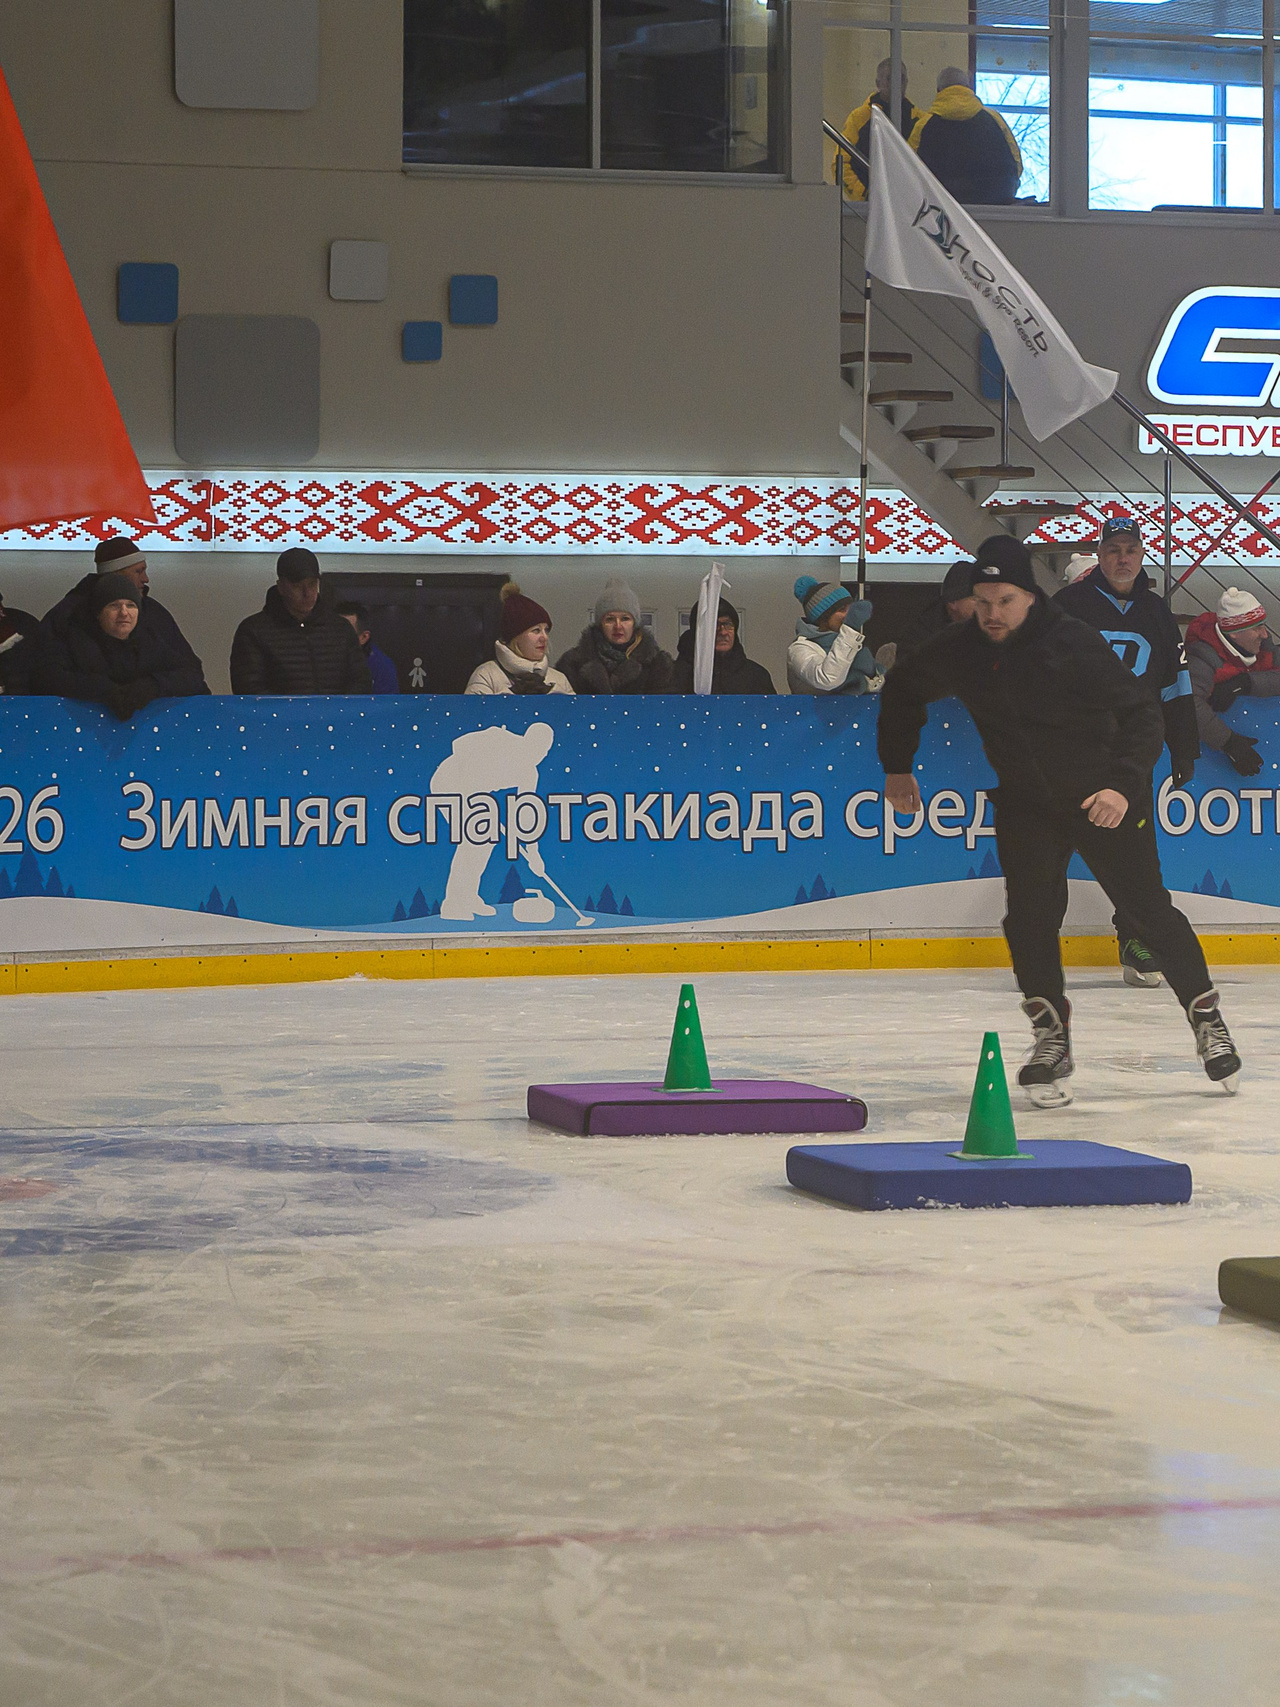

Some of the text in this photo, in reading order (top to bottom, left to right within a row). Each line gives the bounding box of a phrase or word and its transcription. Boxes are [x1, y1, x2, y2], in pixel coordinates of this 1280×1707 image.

[0, 785, 65, 853] 26
[119, 781, 367, 850] Зимняя
[387, 790, 824, 860] спартакиада
[844, 789, 998, 855] сред
